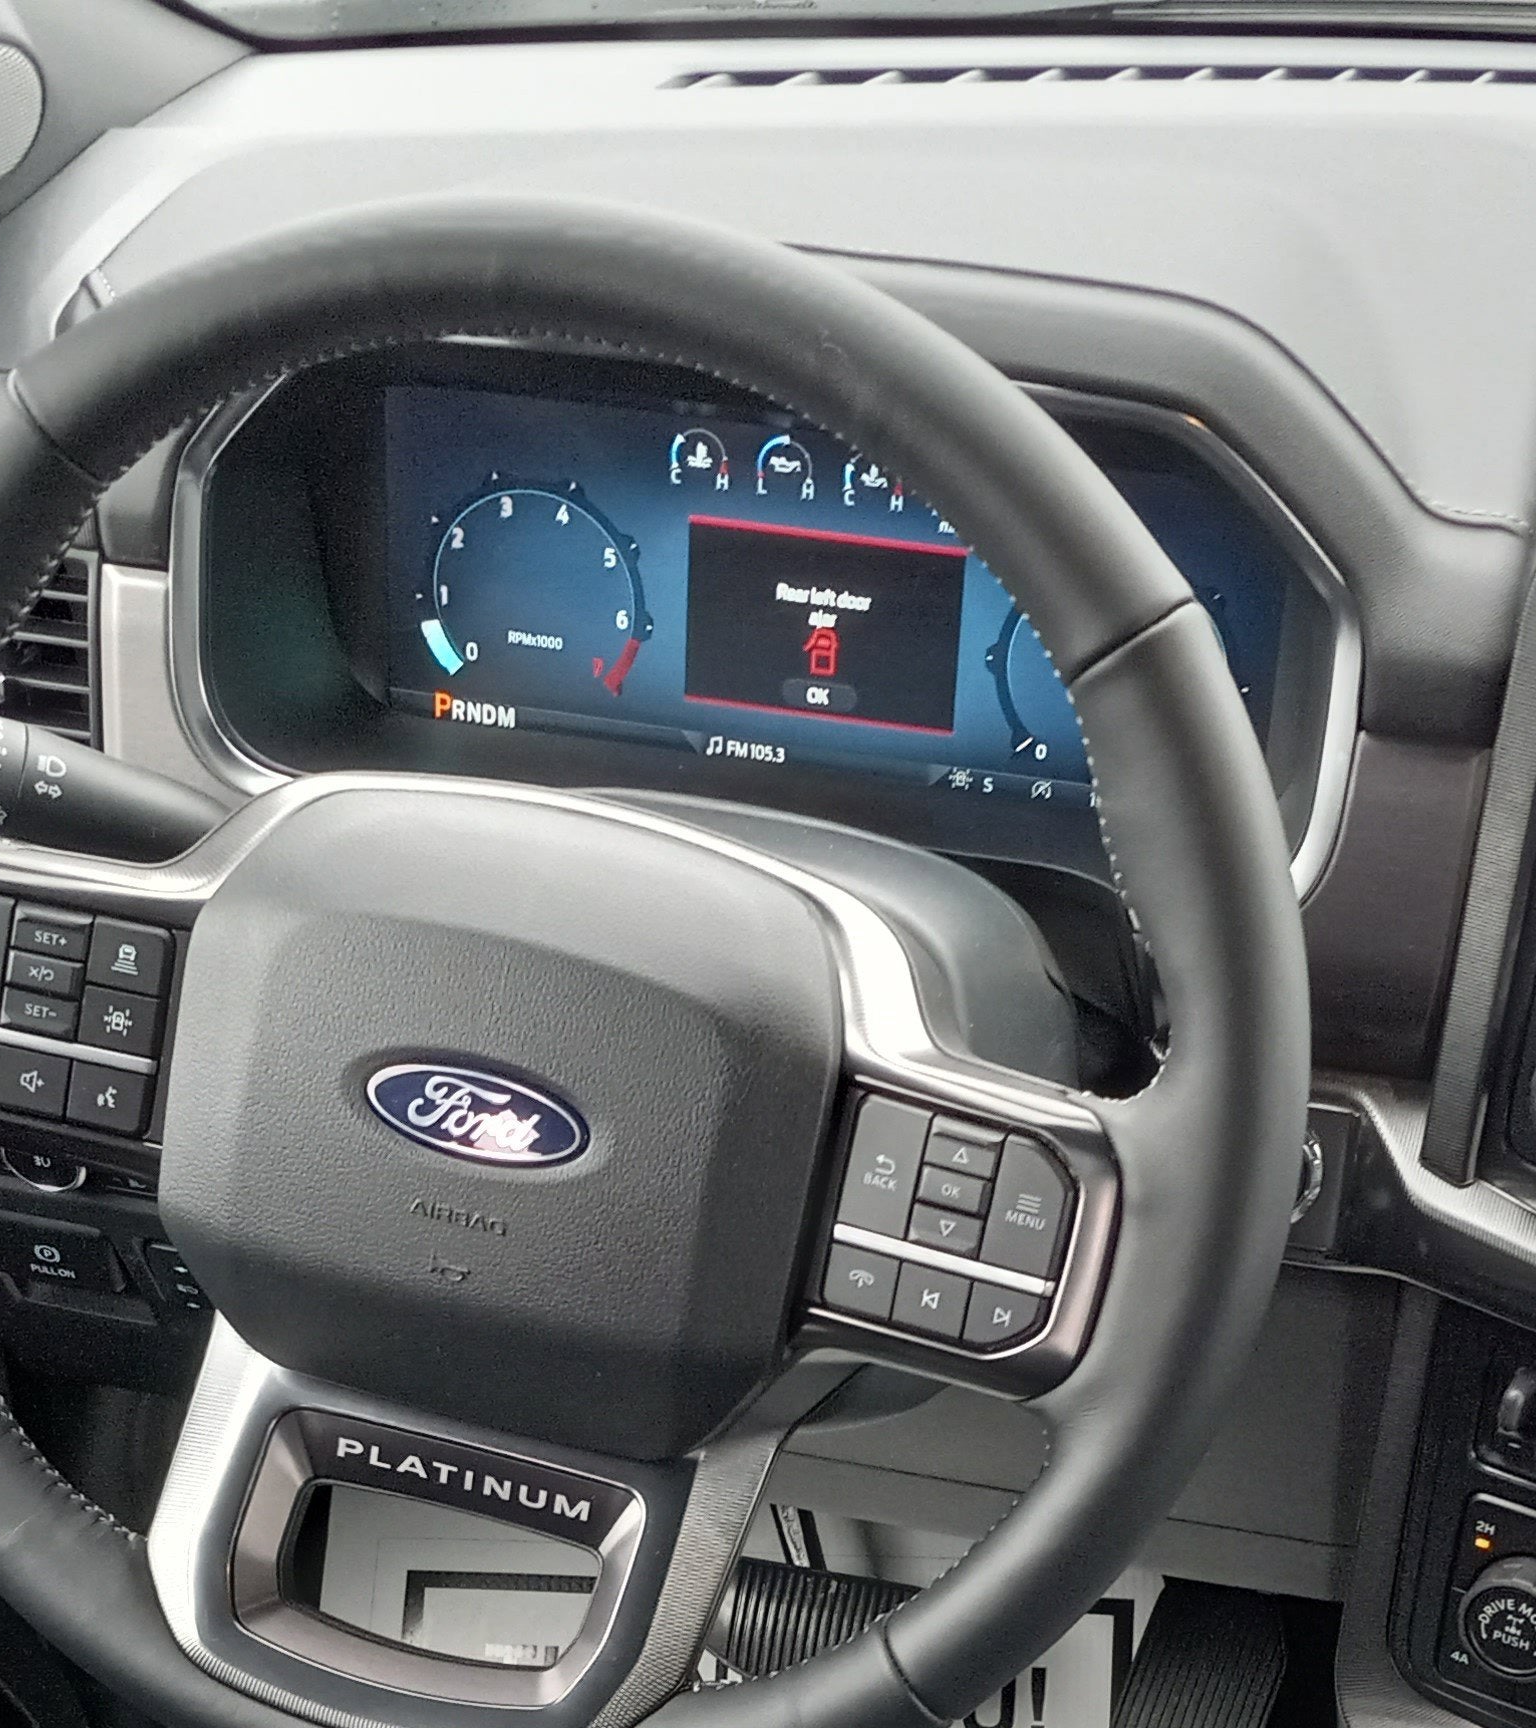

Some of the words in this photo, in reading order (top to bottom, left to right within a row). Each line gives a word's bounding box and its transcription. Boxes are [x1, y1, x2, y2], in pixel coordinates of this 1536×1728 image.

[715, 472, 730, 491] H
[499, 496, 514, 518] 3
[555, 504, 570, 526] 4
[450, 527, 465, 549] 2
[603, 547, 616, 568] 5
[439, 584, 449, 606] 1
[615, 610, 630, 631] 6
[465, 642, 479, 661] 0
[805, 686, 830, 706] OK
[726, 739, 749, 758] FM
[750, 743, 785, 764] 105.3
[1034, 743, 1048, 760] 0
[982, 776, 994, 793] S
[862, 1171, 898, 1191] BACK
[941, 1184, 962, 1198] OK
[1004, 1209, 1046, 1232] MENU
[30, 1263, 59, 1277] PULL
[336, 1437, 591, 1522] PLATINUM
[1474, 1520, 1497, 1536] 2H
[1477, 1598, 1516, 1626] DRIVE
[1492, 1630, 1531, 1651] PUSH
[1449, 1650, 1470, 1665] 4A
